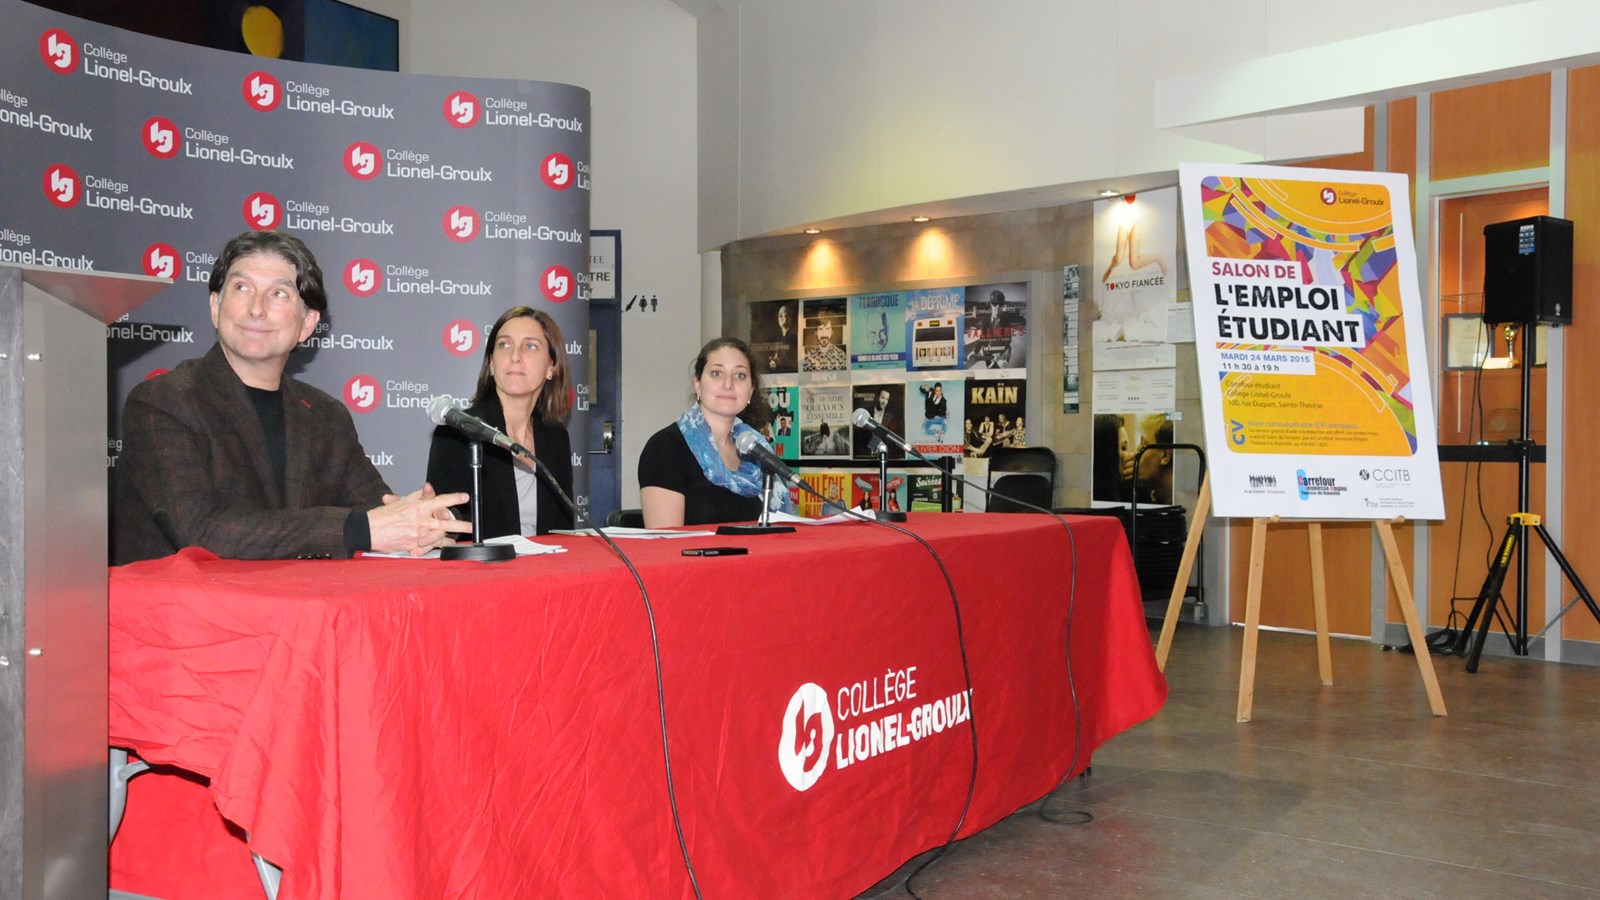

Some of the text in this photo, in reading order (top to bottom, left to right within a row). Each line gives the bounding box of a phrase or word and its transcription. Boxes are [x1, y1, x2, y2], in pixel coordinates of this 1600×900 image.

[84, 43, 127, 62] Collège
[85, 58, 192, 95] Lionel-Groulx
[0, 88, 28, 107] llège
[286, 81, 330, 98] Collège
[287, 95, 394, 119] Lionel-Groulx
[486, 98, 527, 111] Collège
[0, 109, 93, 141] onel-Groulx
[486, 111, 582, 132] Lionel-Groulx
[185, 127, 229, 145] Collège
[186, 142, 294, 171] Lionel-Groulx
[387, 149, 429, 163] Collège
[387, 162, 493, 182] Lionel-Groulx
[86, 175, 128, 194] Collège
[86, 190, 193, 220] Lionel-Groulx
[287, 200, 330, 216] Collège
[287, 213, 394, 235] Lionel-Groulx
[485, 211, 527, 225] Collège
[0, 228, 30, 246] ollège
[486, 224, 582, 244] Lionel-Groulx
[0, 244, 94, 271] ionel-Groulx
[186, 252, 218, 265] Collè
[387, 265, 429, 279] Collège
[1212, 261, 1296, 280] SALON DE
[387, 277, 491, 296] Lionel-Groulx
[1106, 277, 1164, 291] TOKYO FIANCÉE
[1214, 283, 1339, 311] L'EMPLOI
[1217, 308, 1360, 343] ÉTUDIANT
[1221, 352, 1248, 361] MARDI
[1263, 354, 1288, 362] MARS
[1290, 355, 1310, 363] 2015
[1242, 363, 1252, 371] 30
[386, 380, 428, 393] Collège
[971, 382, 1018, 404] KAÏN
[1230, 419, 1246, 446] CV
[939, 445, 960, 453] DION
[1372, 468, 1411, 482] CCITB
[838, 666, 916, 720] COLLÈGE
[836, 688, 973, 769] LIONEL-GROULX
